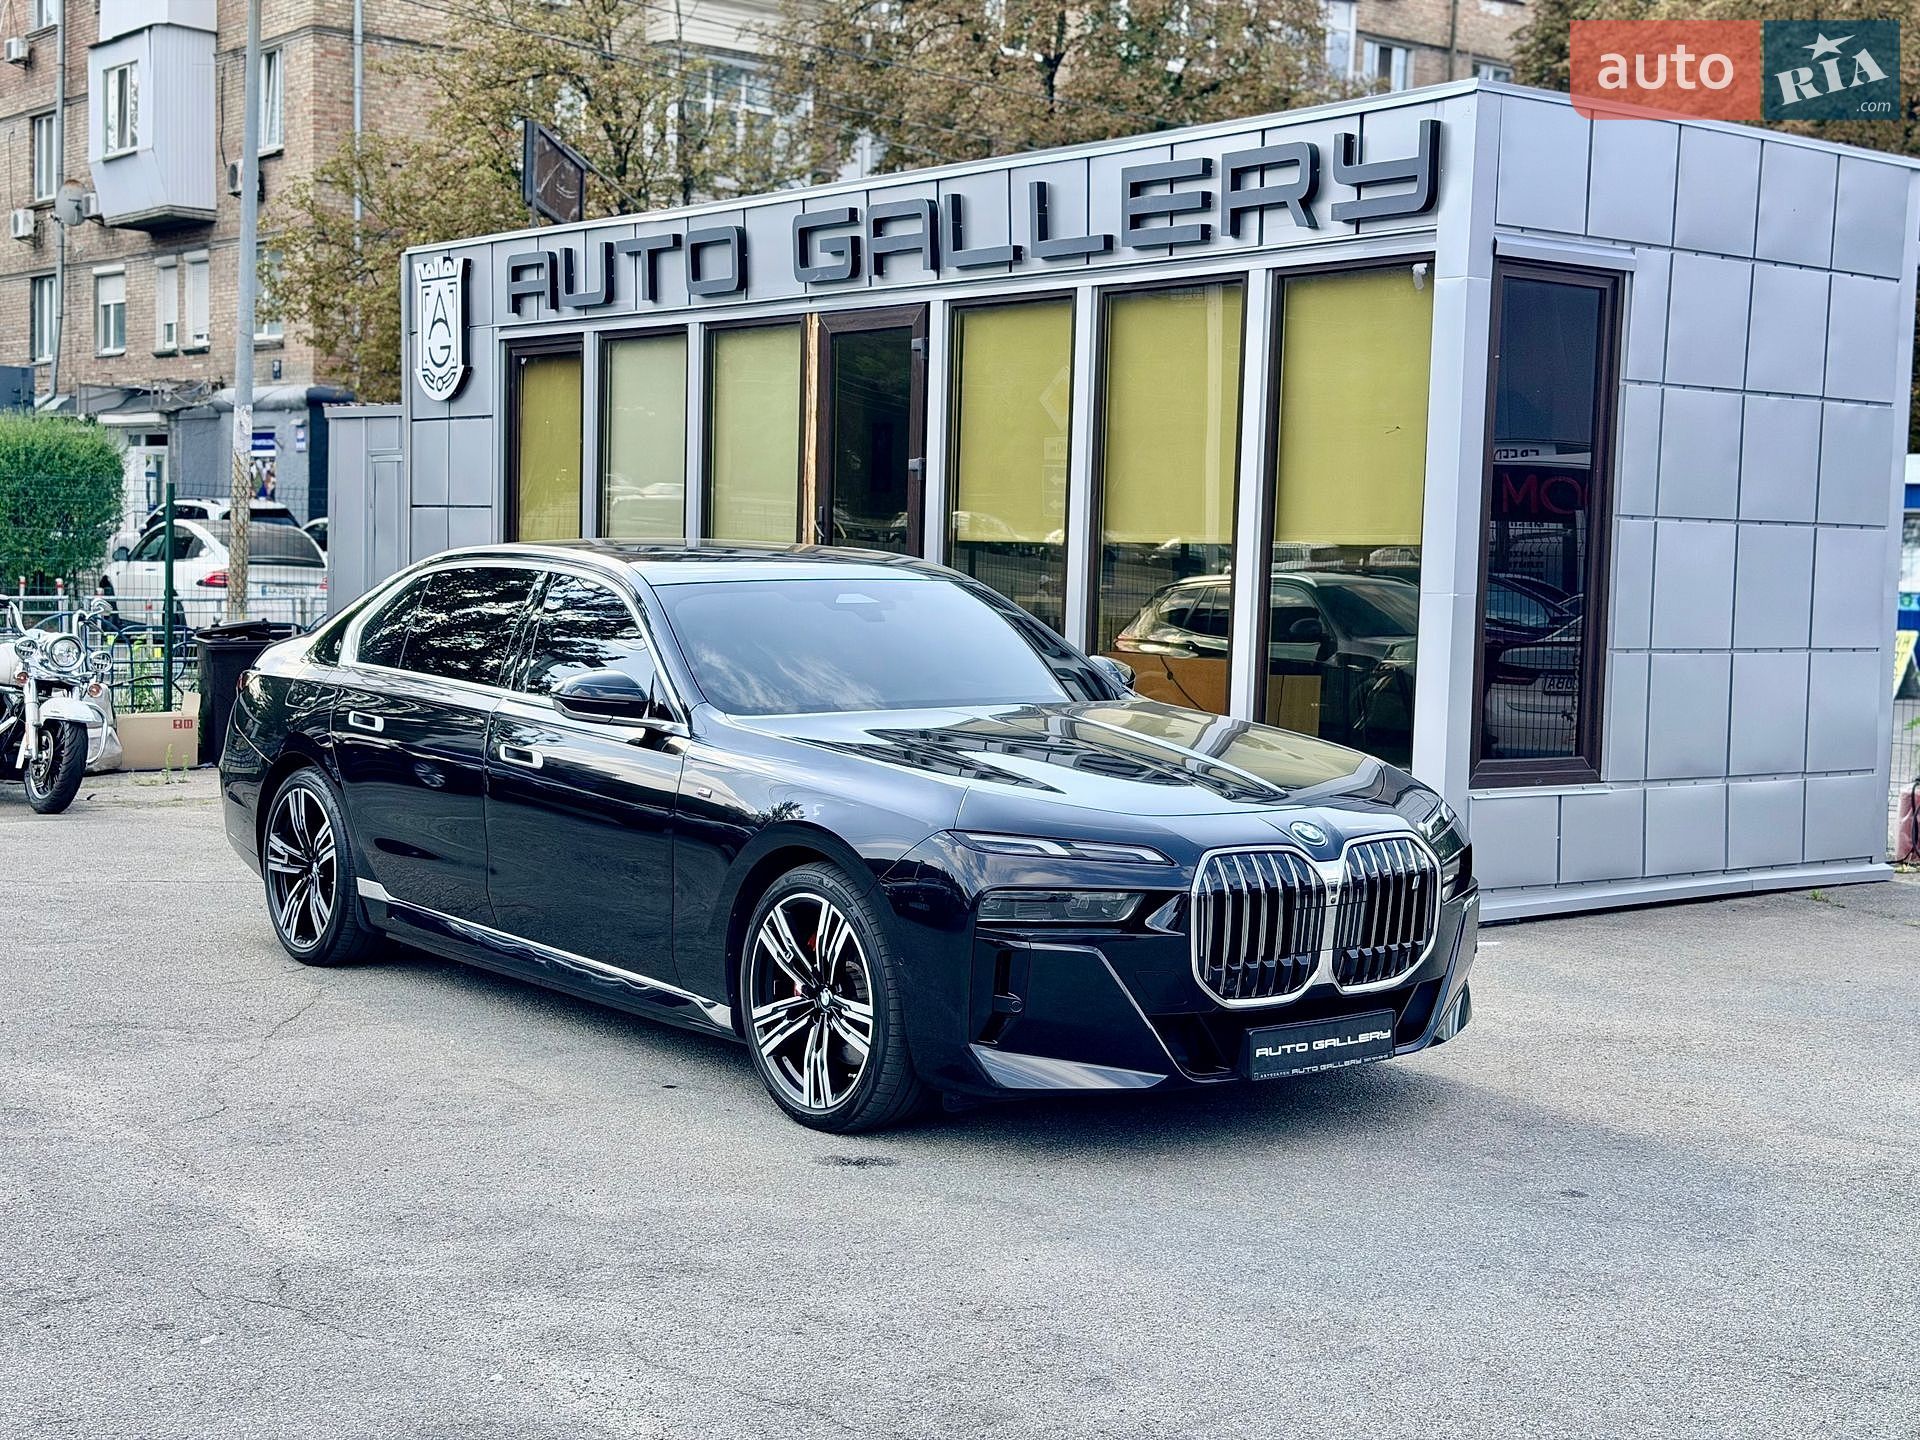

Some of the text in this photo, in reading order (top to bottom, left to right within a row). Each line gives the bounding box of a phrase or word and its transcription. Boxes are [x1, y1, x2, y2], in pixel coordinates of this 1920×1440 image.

[506, 118, 1442, 315] AUTO GALLERY
[1255, 1029, 1391, 1058] AUTO GALLERY
[1291, 1065, 1319, 1075] AUTO
[1320, 1059, 1362, 1071] GALLERY
